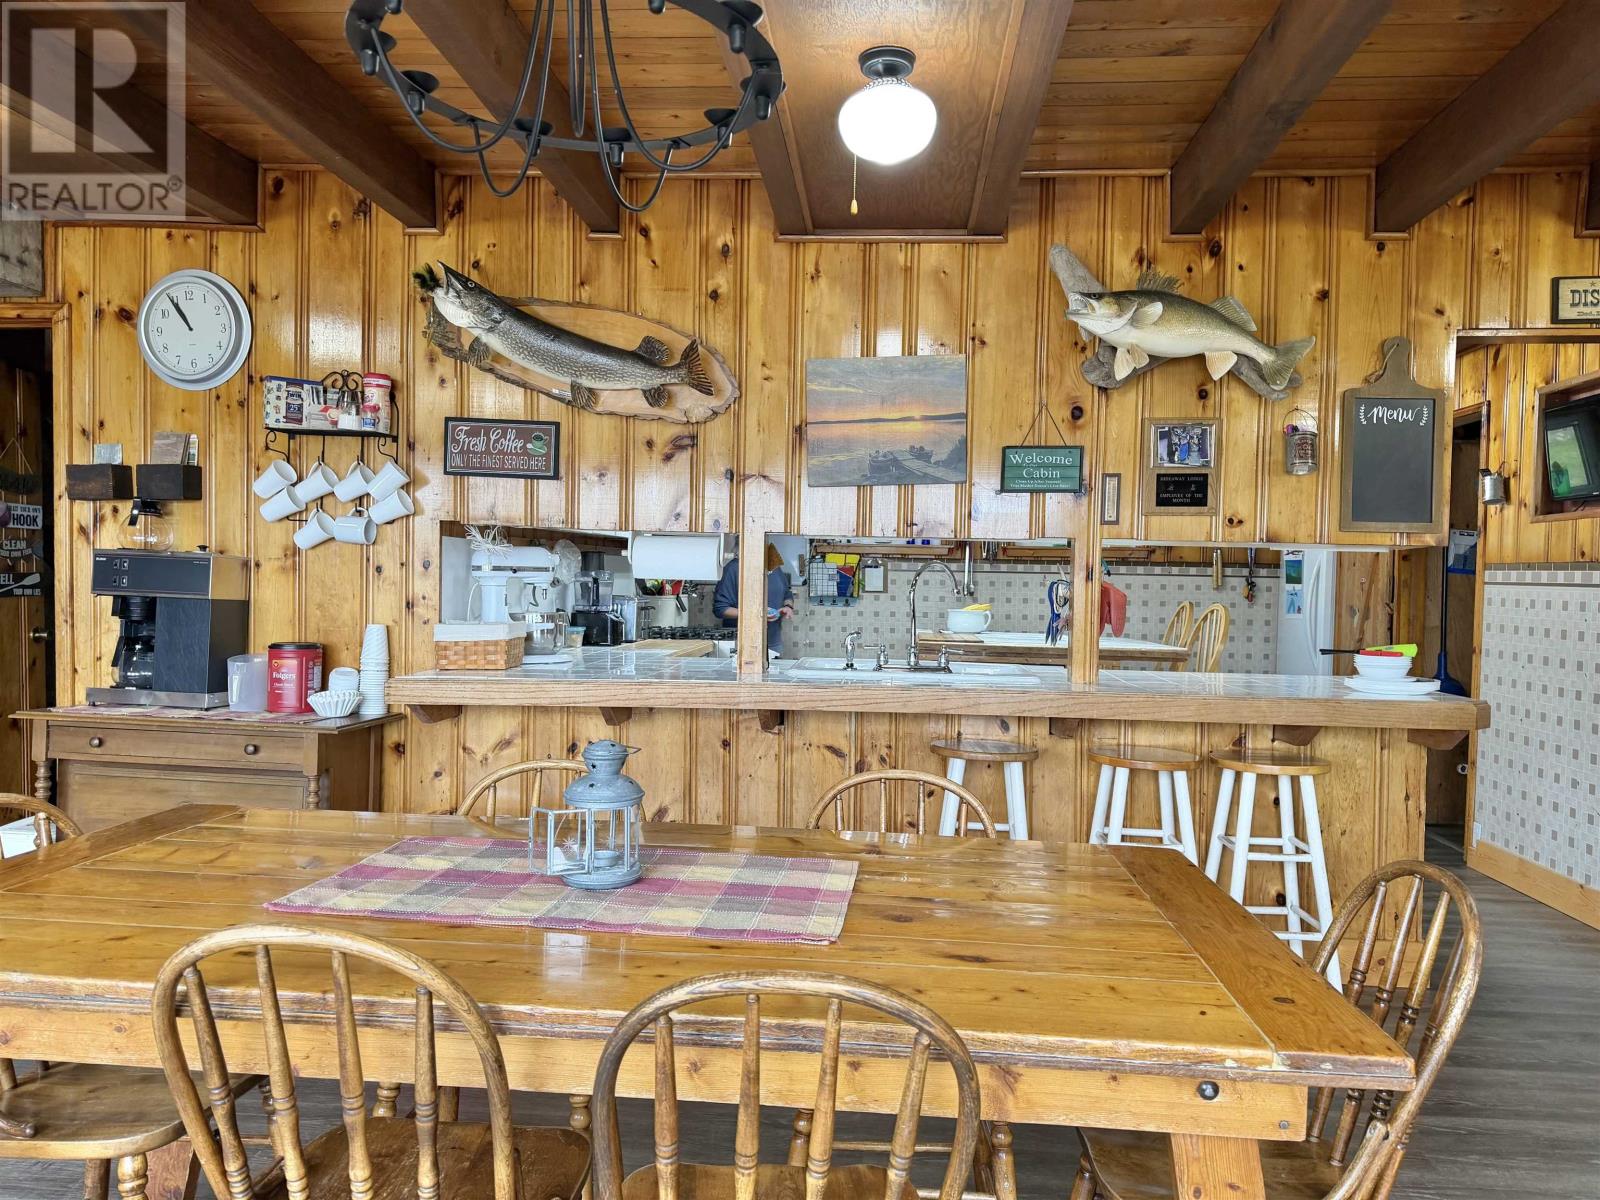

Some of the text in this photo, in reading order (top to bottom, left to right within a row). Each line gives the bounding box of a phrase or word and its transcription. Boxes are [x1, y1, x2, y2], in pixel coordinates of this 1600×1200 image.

[184, 290, 194, 301] 12
[202, 293, 207, 304] 1
[161, 308, 170, 319] 10
[214, 305, 221, 316] 2
[156, 326, 163, 337] 9
[220, 323, 227, 334] 3
[162, 343, 169, 354] 8
[216, 340, 223, 351] 4
[175, 355, 181, 365] 7
[190, 358, 198, 369] 6
[207, 353, 214, 364] 5
[1367, 405, 1420, 425] Menu
[451, 426, 524, 454] Fresh Coffee
[451, 453, 546, 470] ONLY THE FINEST SERVED HERE
[1009, 452, 1073, 465] Welcome
[1023, 467, 1060, 478] Cabin
[12, 513, 39, 527] HOOK
[2, 540, 26, 550] CLEAN
[0, 573, 15, 585] ELL
[272, 672, 296, 680] Folgers
